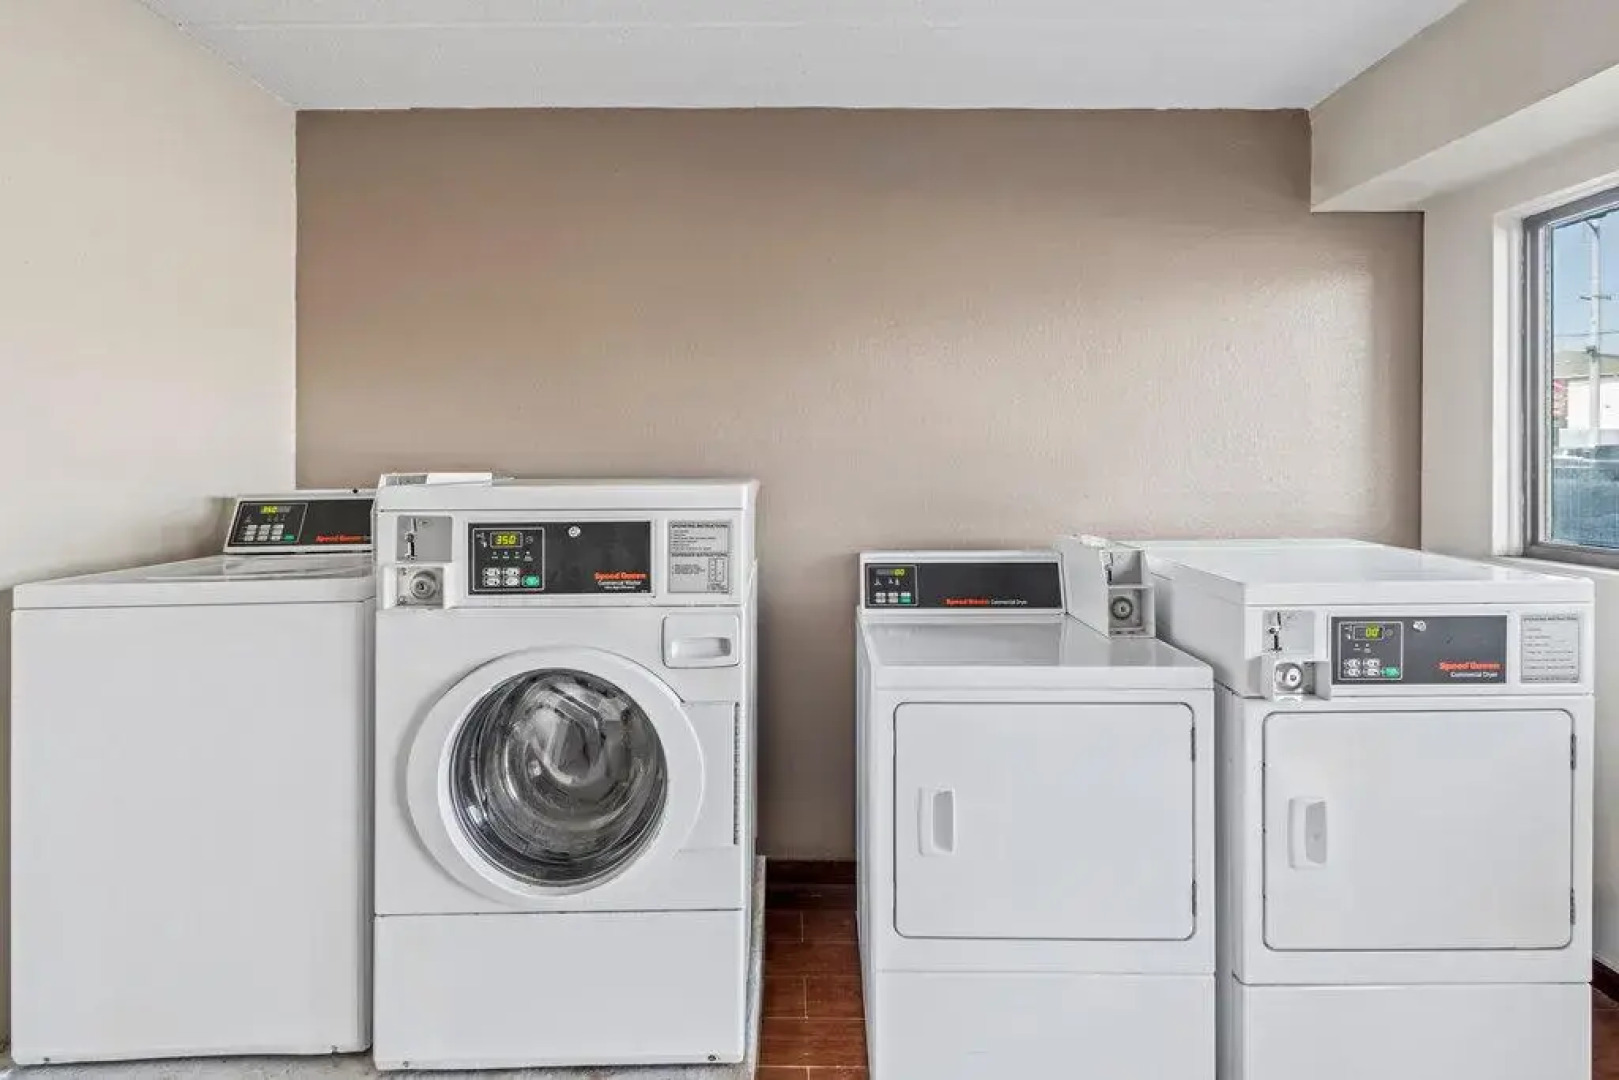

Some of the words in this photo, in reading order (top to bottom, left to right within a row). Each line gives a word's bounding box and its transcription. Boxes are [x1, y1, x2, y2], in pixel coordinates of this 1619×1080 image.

[495, 535, 517, 545] 350
[594, 572, 620, 582] Speed
[620, 572, 646, 580] Queen
[1440, 661, 1469, 671] Speed
[1469, 661, 1500, 670] Queen
[1482, 671, 1498, 679] Dryer
